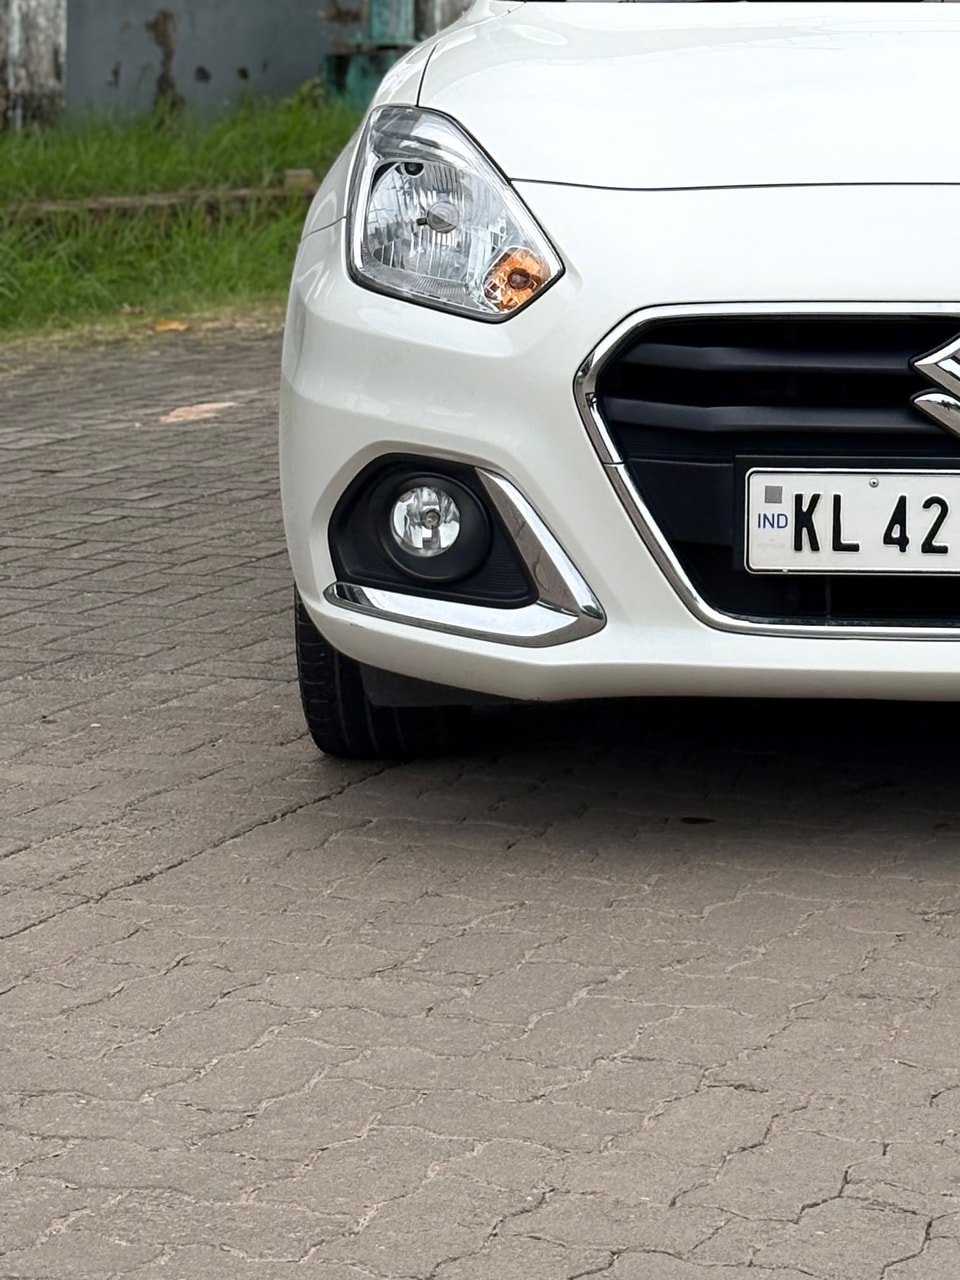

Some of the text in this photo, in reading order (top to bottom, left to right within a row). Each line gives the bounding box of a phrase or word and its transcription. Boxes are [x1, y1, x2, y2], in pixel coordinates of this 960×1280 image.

[757, 513, 788, 529] IND
[794, 493, 860, 552] KL
[883, 495, 949, 554] 42
